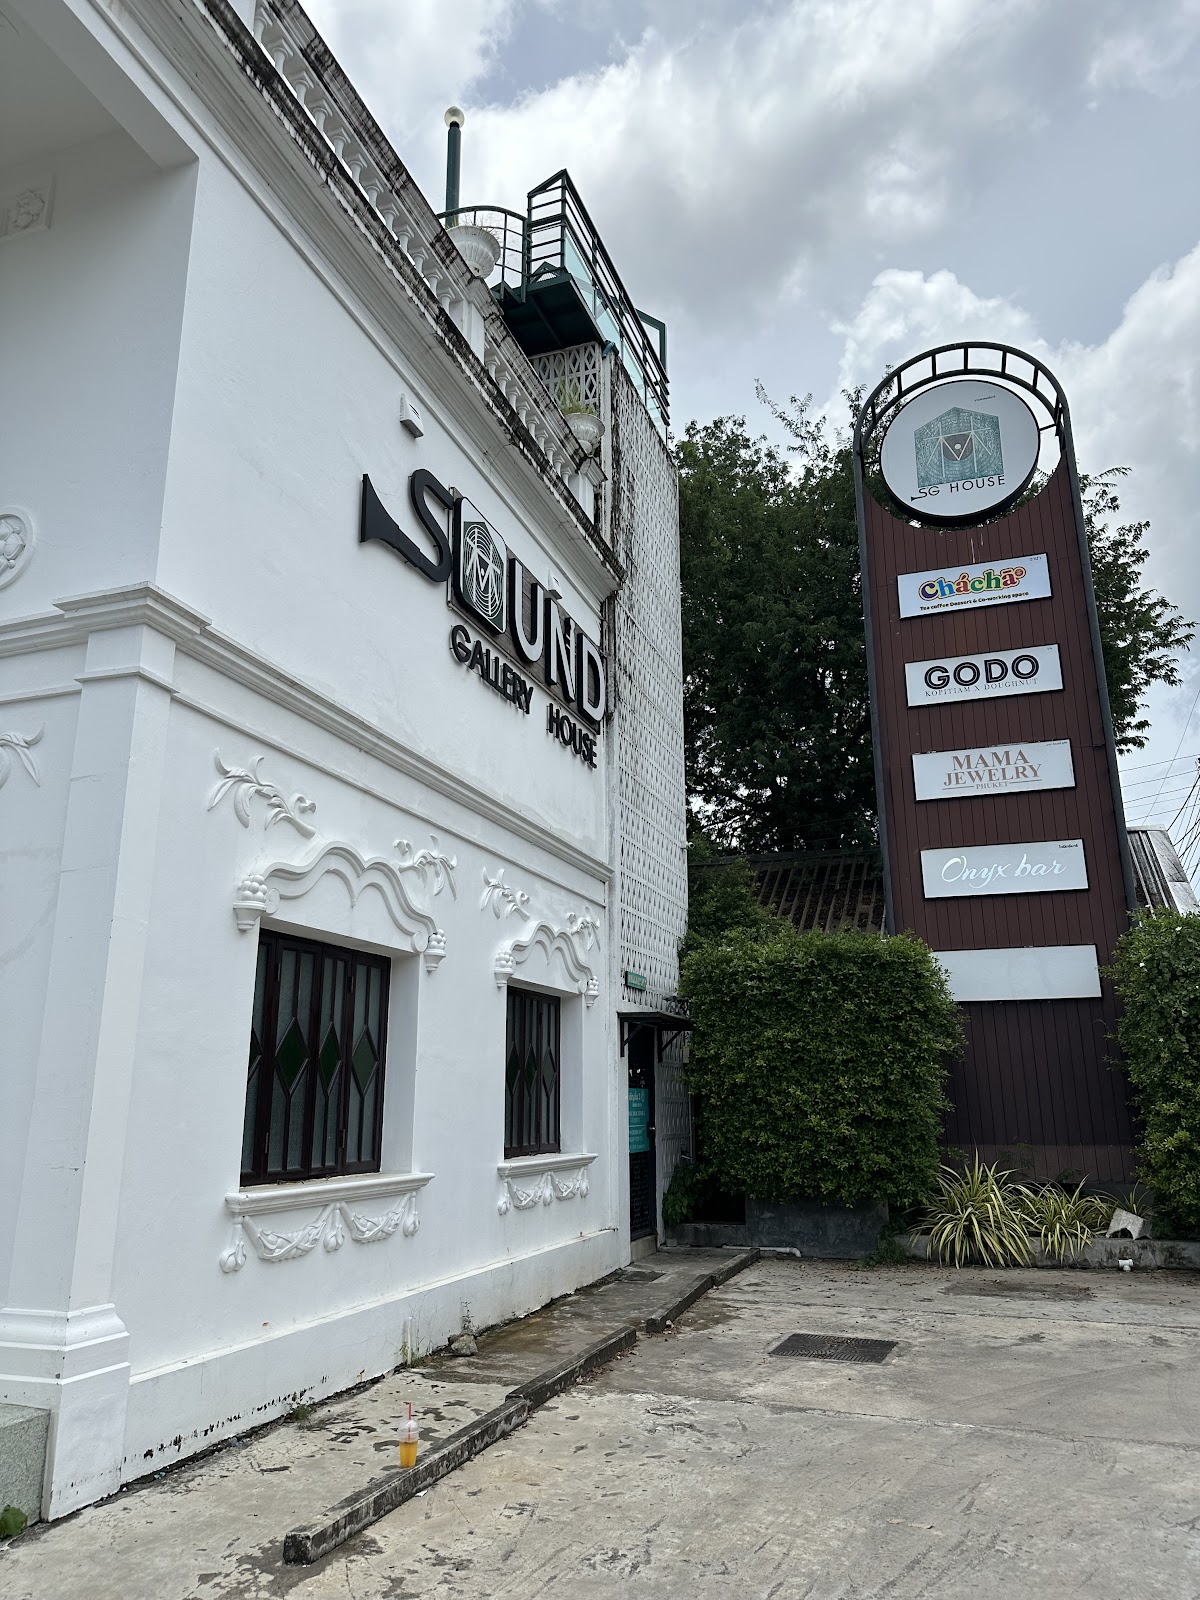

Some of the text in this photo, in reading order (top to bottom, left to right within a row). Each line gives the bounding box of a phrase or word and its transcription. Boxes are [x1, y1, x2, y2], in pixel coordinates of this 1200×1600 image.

[911, 475, 1006, 502] SG HOUSE
[950, 599, 972, 607] Dessert
[978, 594, 1011, 603] Co-working
[924, 654, 1040, 690] GODO
[451, 625, 598, 769] GALLERY HOUSE
[925, 686, 971, 697] KOPITIAM
[984, 678, 1038, 691] DOUGHNUT
[951, 749, 1030, 771] MAMA
[943, 763, 1042, 786] JEWELRY
[975, 781, 1009, 790] PHUKET
[941, 853, 1067, 889] Onyx bar
